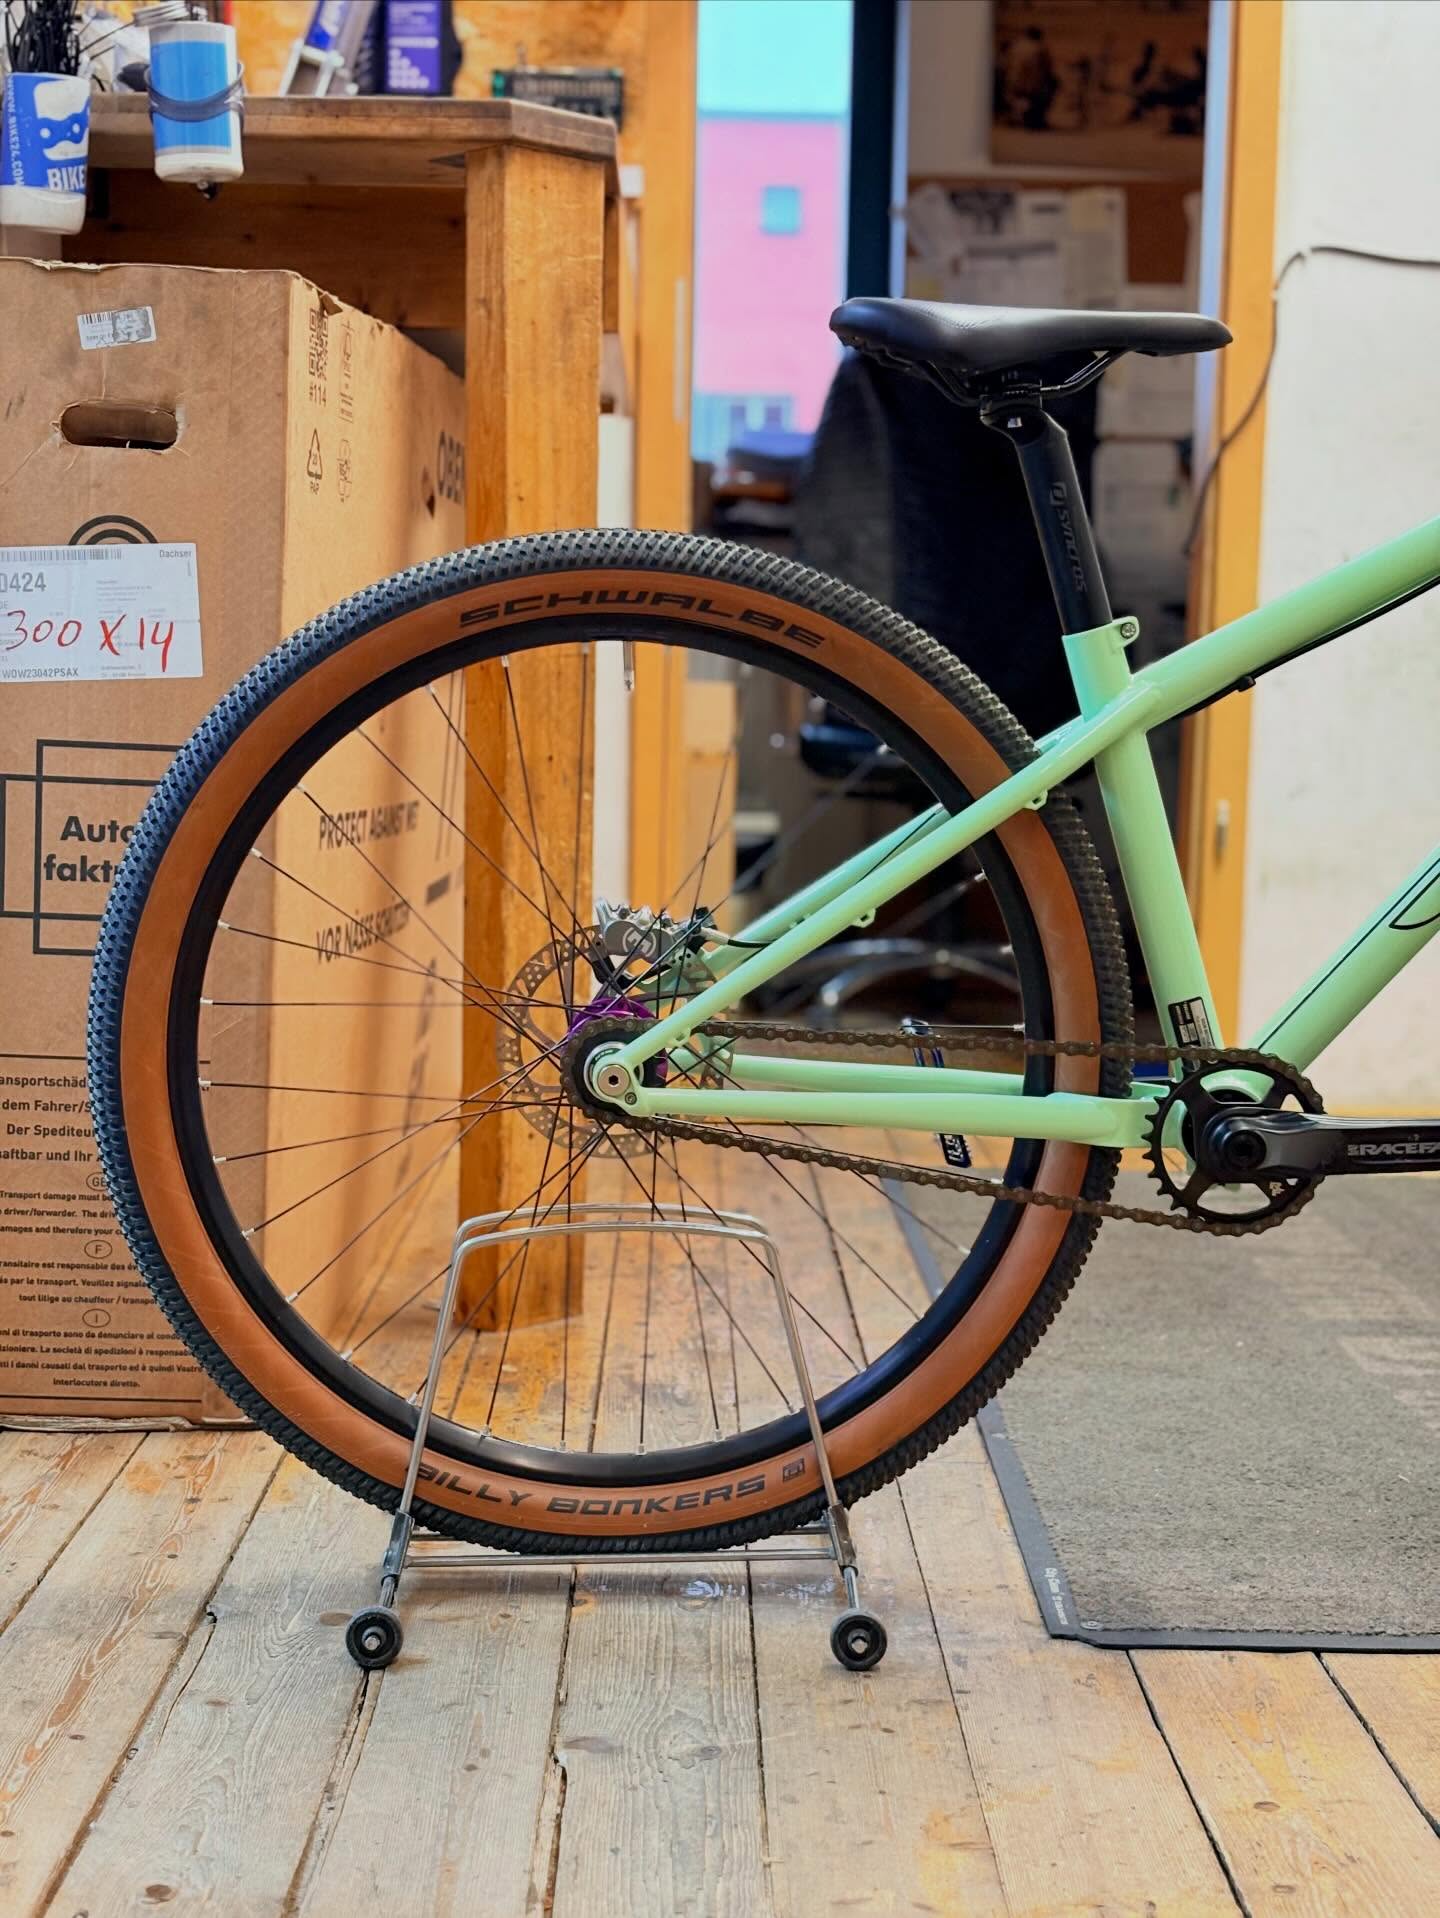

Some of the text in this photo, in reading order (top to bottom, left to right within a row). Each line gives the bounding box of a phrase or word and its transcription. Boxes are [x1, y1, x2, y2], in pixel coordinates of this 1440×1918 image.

[47, 165, 86, 191] BIKE
[159, 549, 192, 559] Dachser
[459, 590, 825, 648] SCHWALBE
[6, 609, 82, 650] 300
[140, 617, 174, 672] 14
[60, 816, 134, 843] Auto
[319, 809, 368, 850] PROTECT
[316, 925, 341, 964] VOR
[2, 1099, 30, 1111] dem
[6, 1123, 30, 1135] Der
[0, 1148, 93, 1162] aftbar und Ihr
[0, 1190, 41, 1200] Transport
[43, 1192, 76, 1201] damage
[78, 1193, 100, 1201] must
[81, 1209, 97, 1217] The
[35, 1226, 50, 1234] and
[52, 1226, 92, 1235] therefore
[94, 1228, 113, 1236] your
[95, 1245, 103, 1255] F
[57, 1262, 108, 1270] responsable
[10, 1278, 24, 1286] par
[26, 1277, 34, 1285] le
[80, 1278, 114, 1287] Veuillez
[19, 1294, 36, 1302] tout
[74, 1296, 114, 1304] chauffeur
[22, 1329, 61, 1338] trasporto
[98, 1331, 145, 1340] denunciare
[40, 1345, 50, 1353] La
[84, 1346, 92, 1354] di
[547, 1474, 765, 1516] BONKERS
